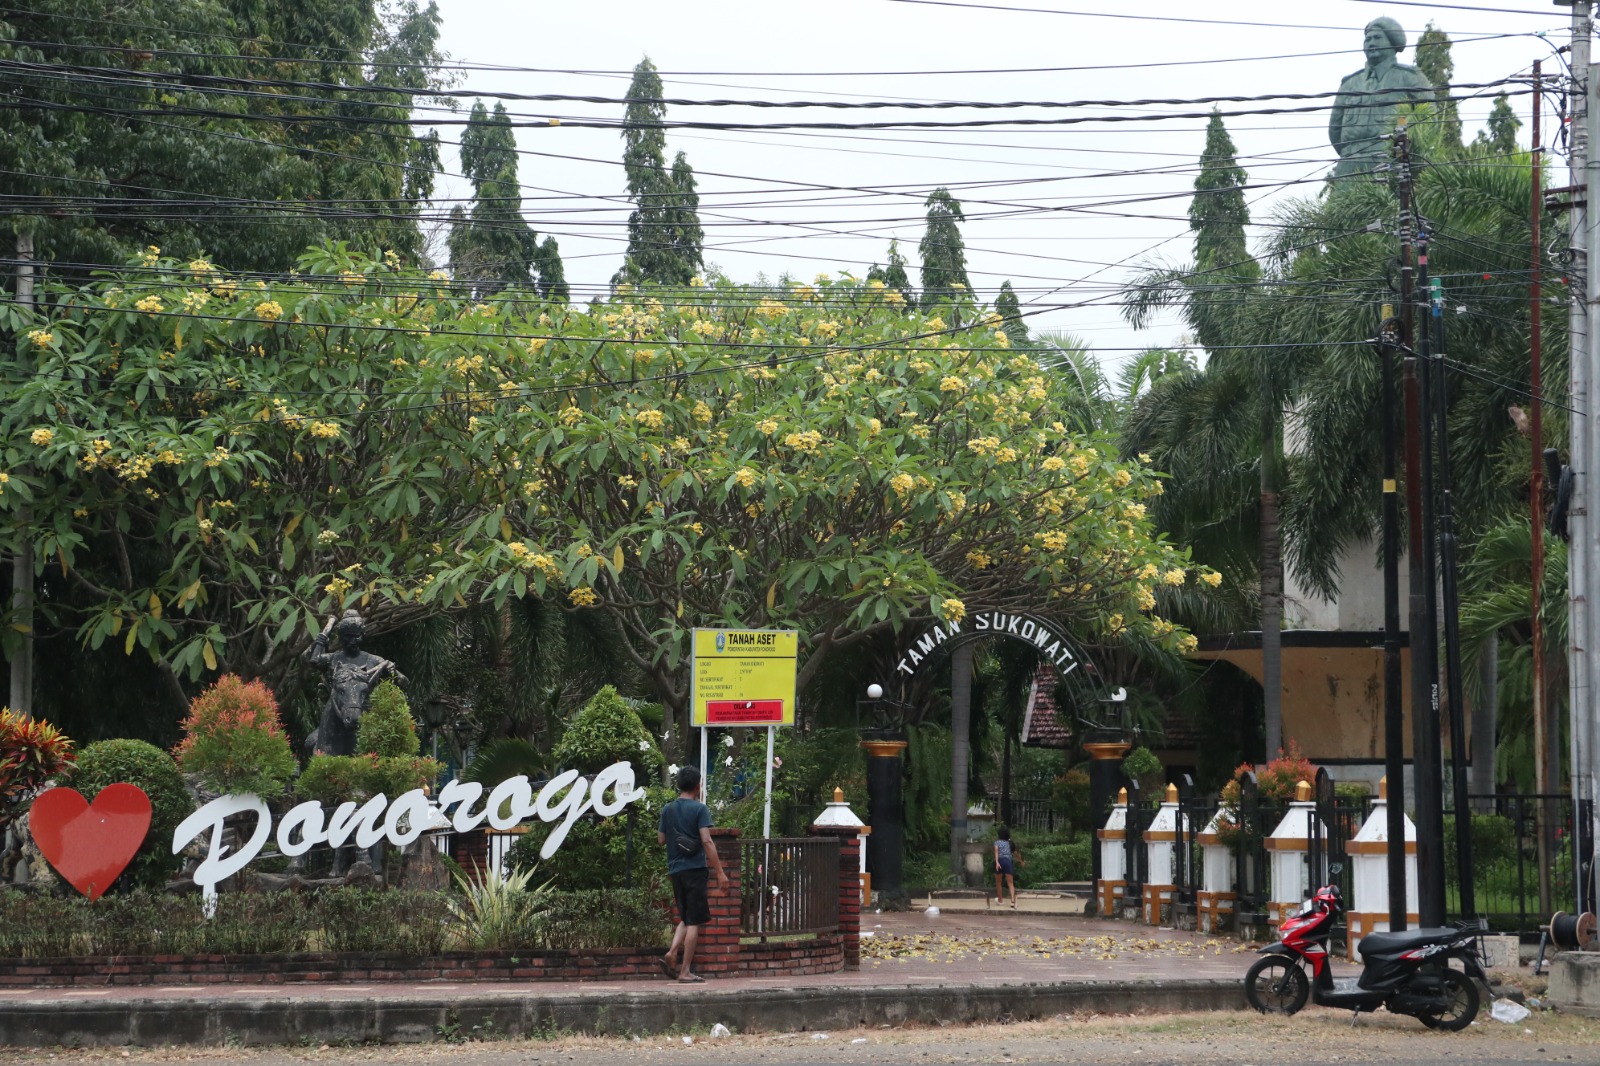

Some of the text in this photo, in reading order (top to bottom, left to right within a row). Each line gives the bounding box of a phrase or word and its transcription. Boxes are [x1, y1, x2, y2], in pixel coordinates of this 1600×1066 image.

[728, 633, 755, 645] TANAH
[757, 633, 776, 645] ASET
[896, 611, 1078, 676] TAMAN SUKOWATI
[172, 760, 644, 887] Ponorogo
